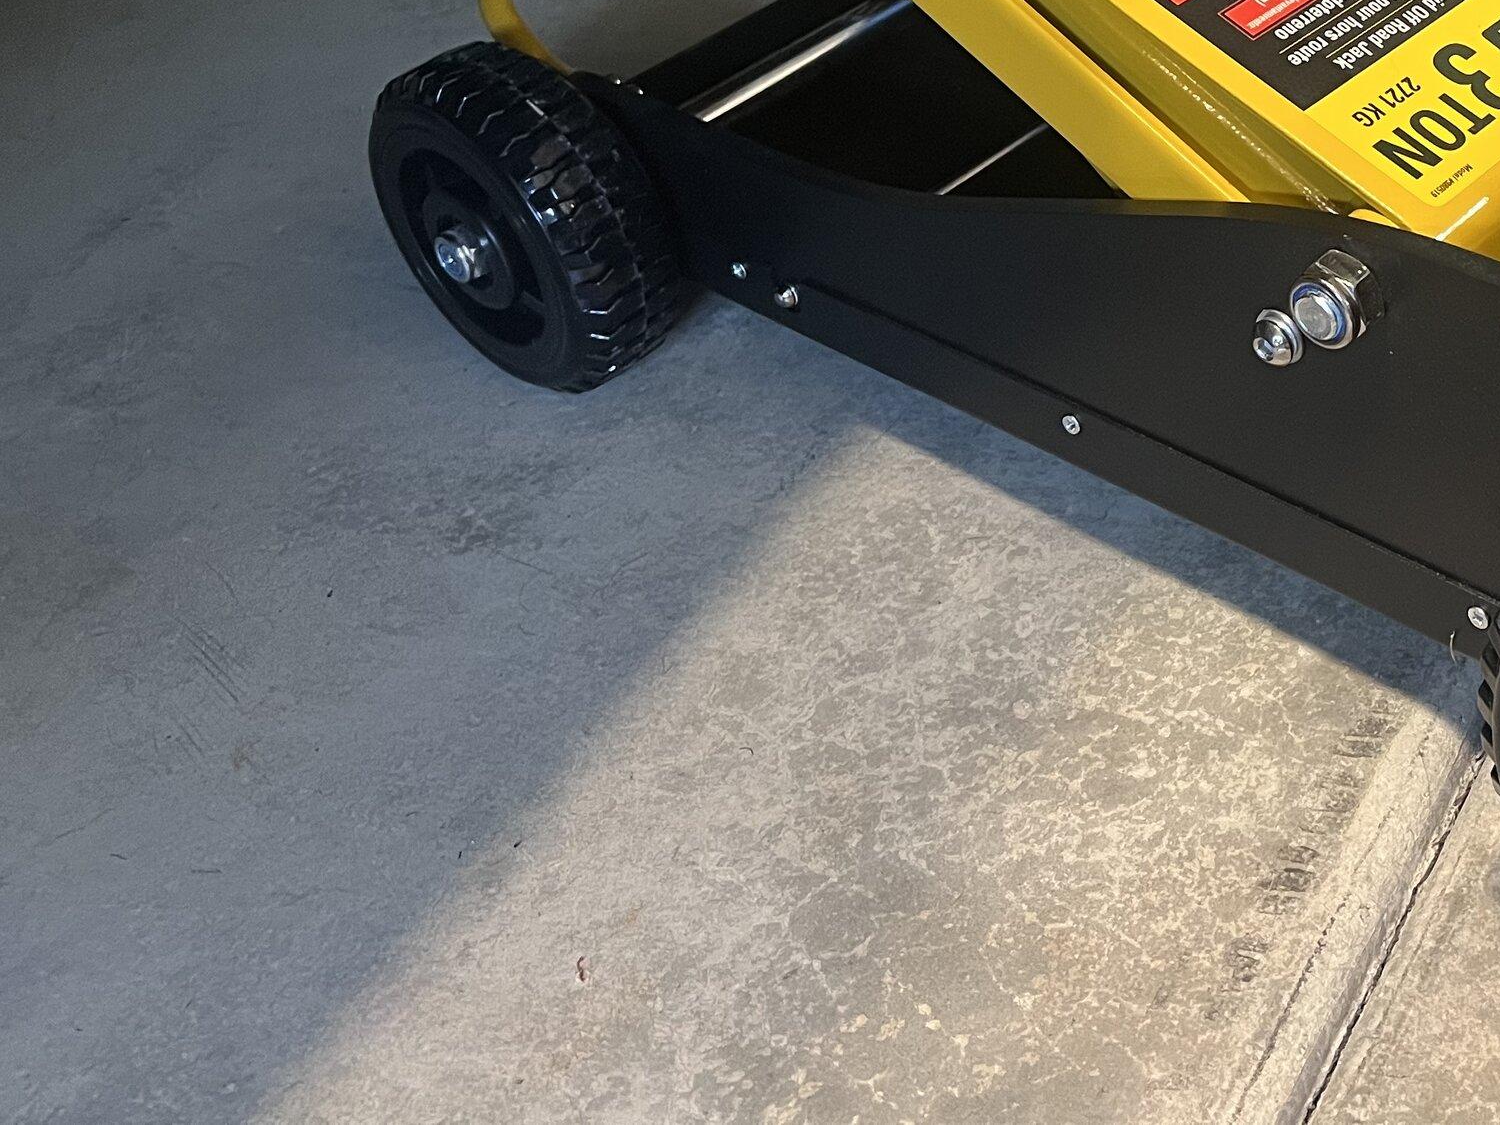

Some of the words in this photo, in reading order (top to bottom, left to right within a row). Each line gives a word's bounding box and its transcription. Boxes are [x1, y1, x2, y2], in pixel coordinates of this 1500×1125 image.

[1323, 15, 1364, 41] hors
[1401, 4, 1430, 26] Off
[1366, 17, 1410, 49] Road
[1286, 35, 1329, 65] route
[1331, 40, 1373, 69] Jack
[1377, 75, 1421, 108] 2721
[1350, 102, 1386, 127] KG
[1371, 92, 1496, 180] TON
[1453, 163, 1473, 181] Model
